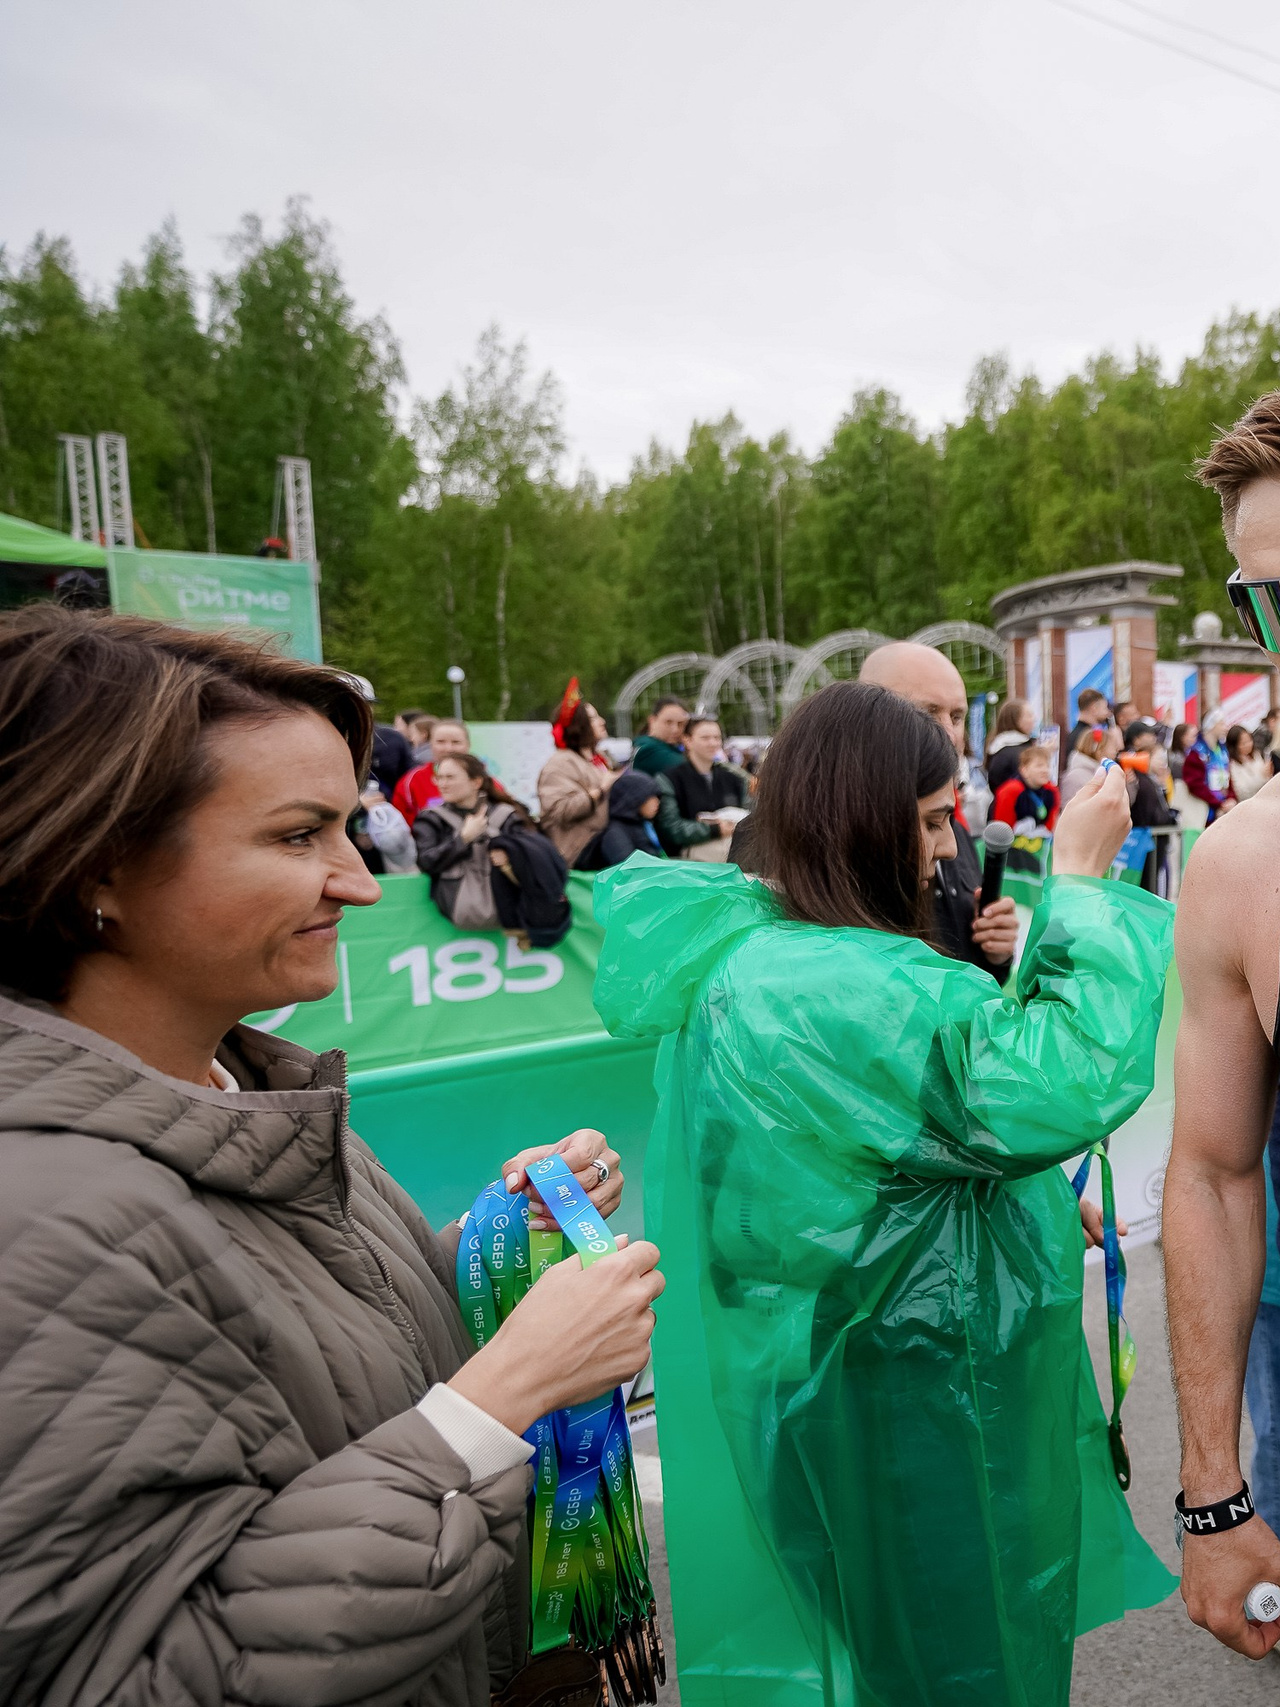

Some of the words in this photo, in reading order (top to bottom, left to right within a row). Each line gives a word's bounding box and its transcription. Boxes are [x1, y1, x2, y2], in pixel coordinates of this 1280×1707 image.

[388, 937, 565, 1006] 185
[577, 1220, 600, 1241] СБЕР
[492, 1233, 506, 1270] СБЕР
[469, 1252, 483, 1290] СБЕР
[473, 1305, 486, 1329] 185
[476, 1332, 485, 1349] ле
[579, 1428, 594, 1451] Utair
[543, 1445, 552, 1485] СБЕР
[607, 1450, 618, 1478] СБЕР
[566, 1487, 582, 1516] СБЕР
[562, 1542, 572, 1560] лет
[591, 1532, 602, 1550] лет
[556, 1561, 569, 1580] 185
[595, 1551, 606, 1570] 185
